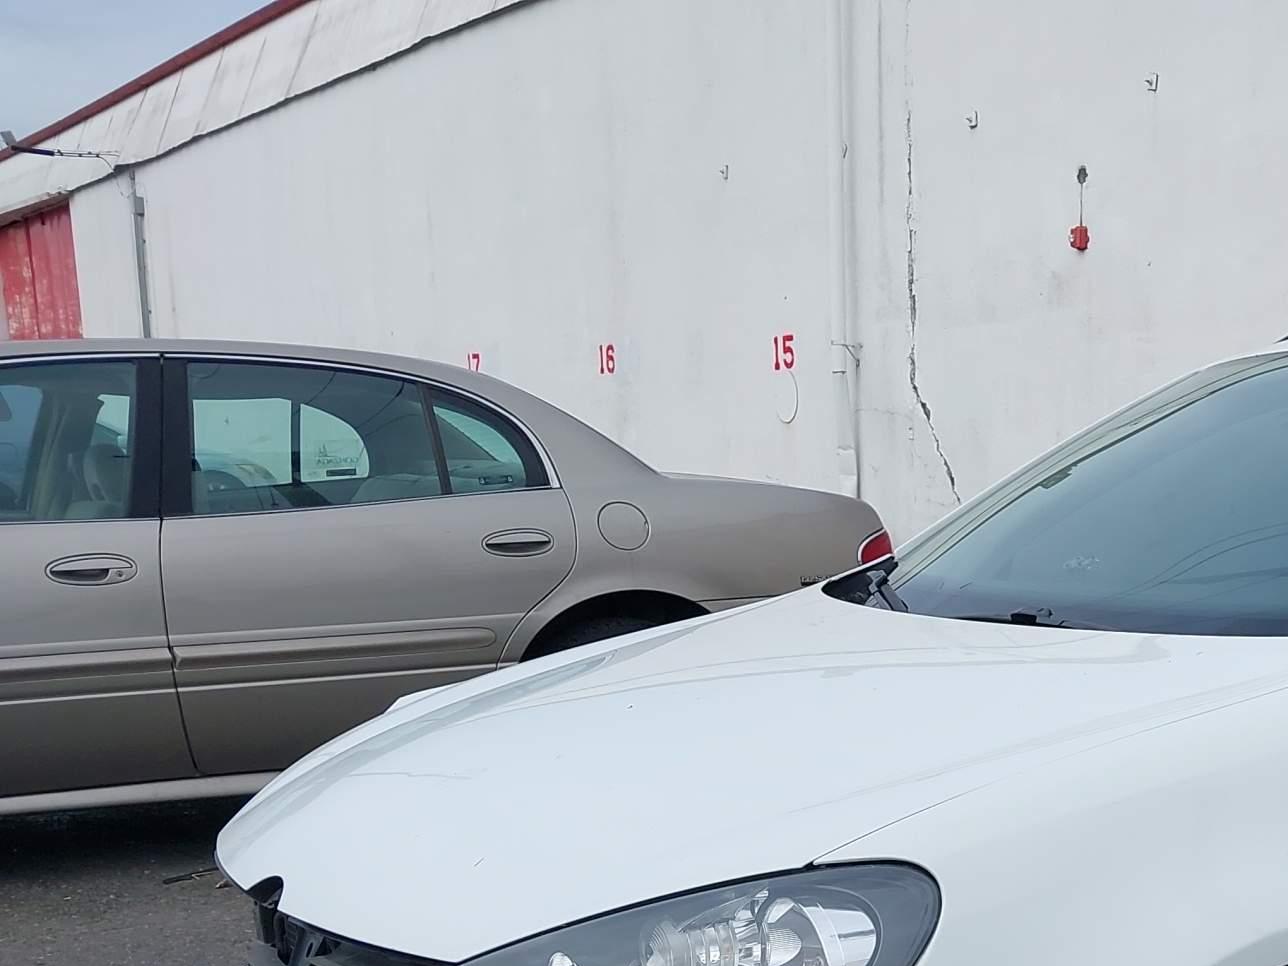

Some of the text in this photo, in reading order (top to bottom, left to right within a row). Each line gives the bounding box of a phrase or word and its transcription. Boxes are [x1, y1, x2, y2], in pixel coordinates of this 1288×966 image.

[467, 352, 481, 372] 17
[599, 344, 616, 374] 16
[773, 335, 795, 371] 15
